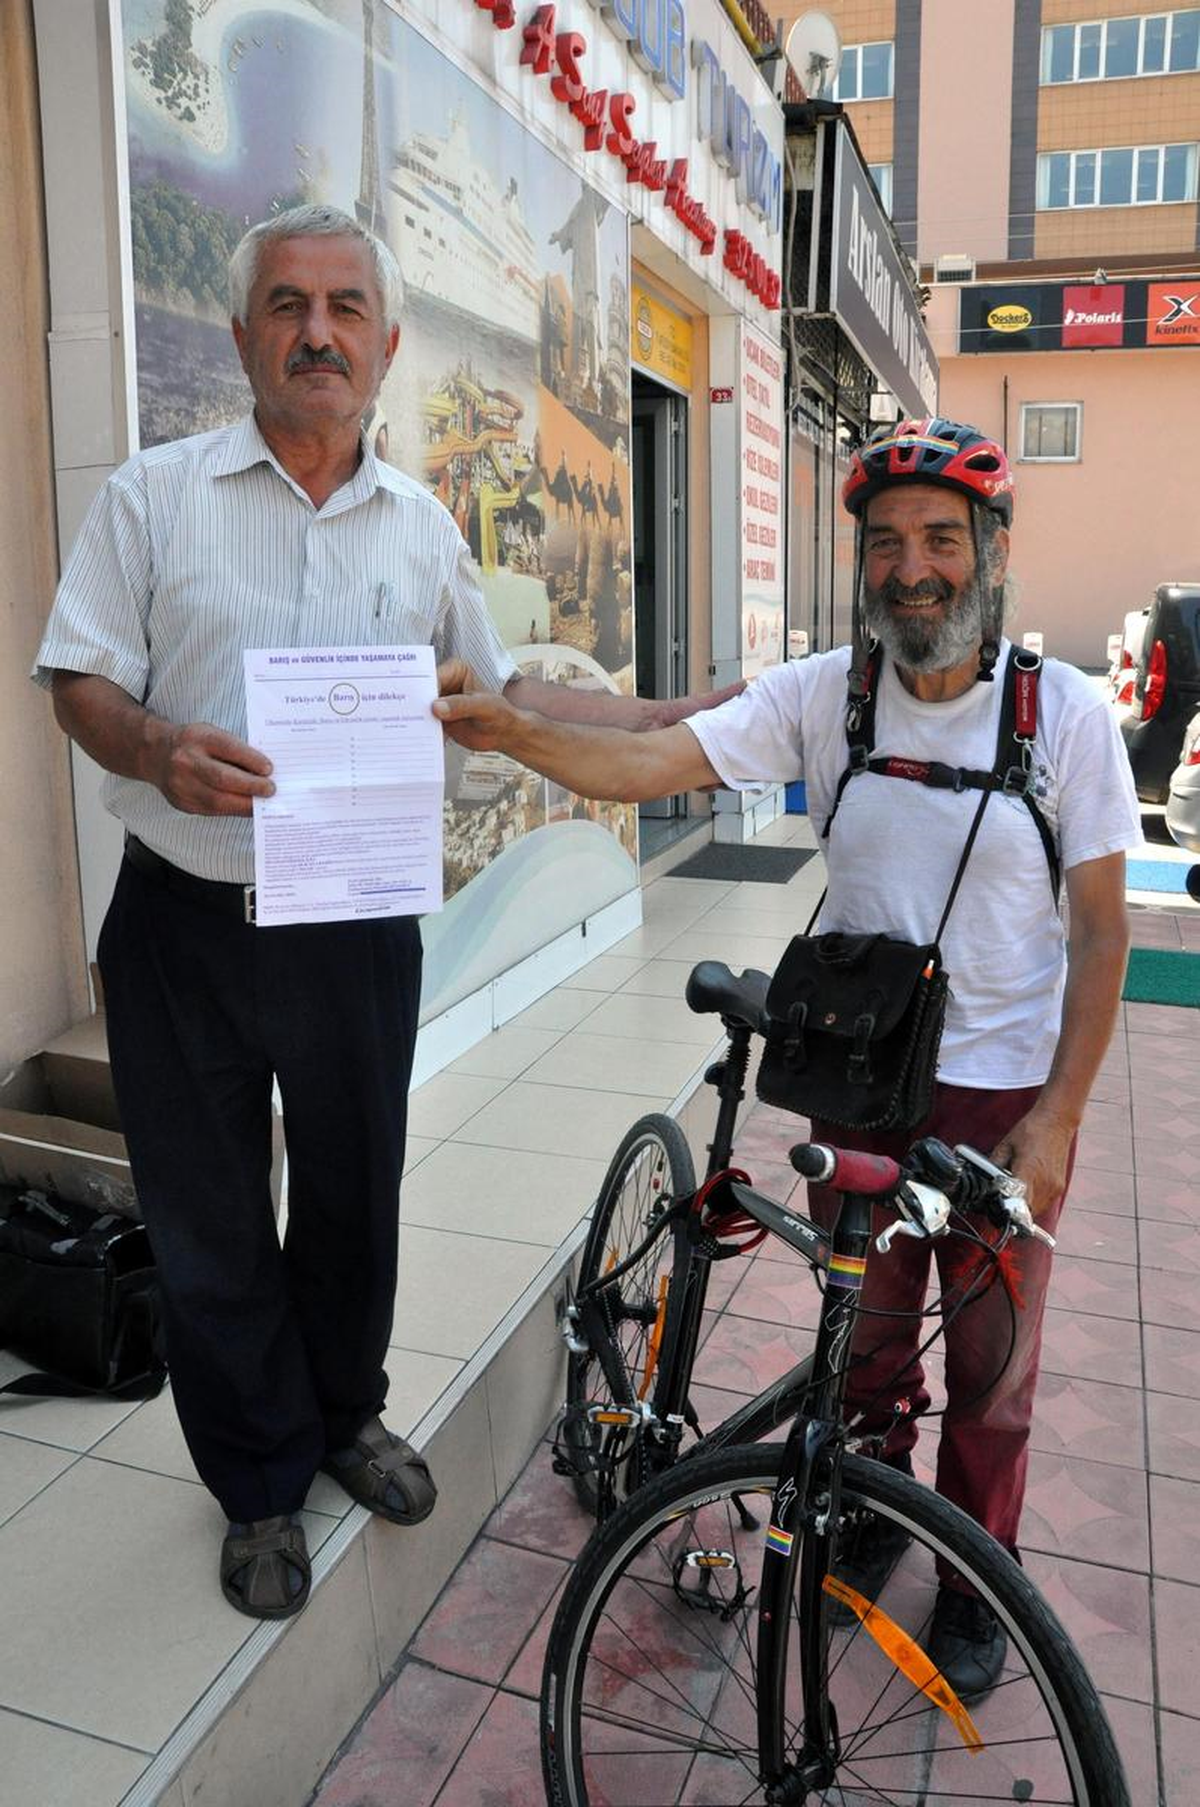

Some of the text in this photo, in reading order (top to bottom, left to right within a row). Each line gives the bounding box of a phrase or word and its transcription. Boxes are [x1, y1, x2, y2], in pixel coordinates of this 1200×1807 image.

[847, 185, 891, 337] Arslan
[1075, 312, 1123, 324] Polaris
[269, 656, 290, 666] BARIŞ
